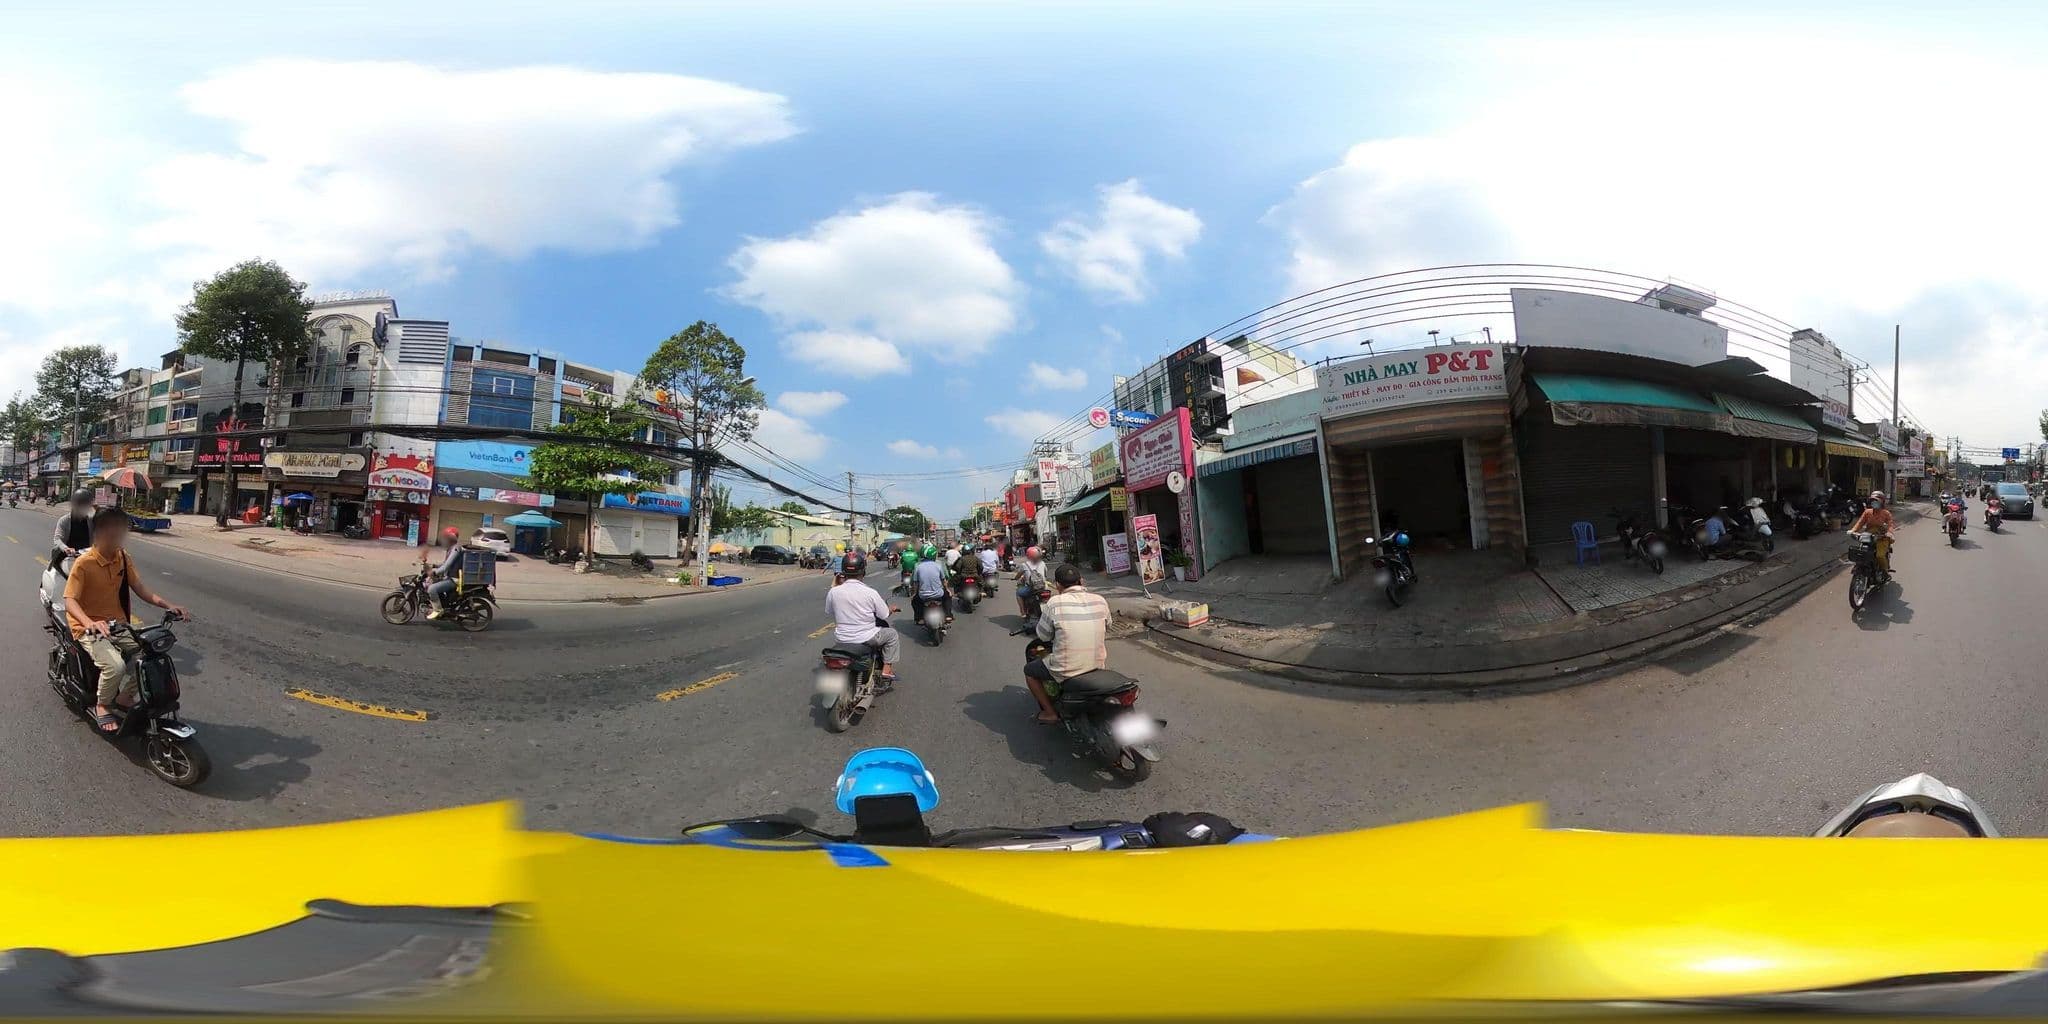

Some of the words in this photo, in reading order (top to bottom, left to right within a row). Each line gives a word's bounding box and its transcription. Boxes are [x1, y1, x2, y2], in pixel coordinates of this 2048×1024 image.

[1344, 366, 1378, 386] NHÀ
[1384, 361, 1418, 378] MAY
[1424, 350, 1493, 374] P&T
[469, 451, 514, 464] VietinBank
